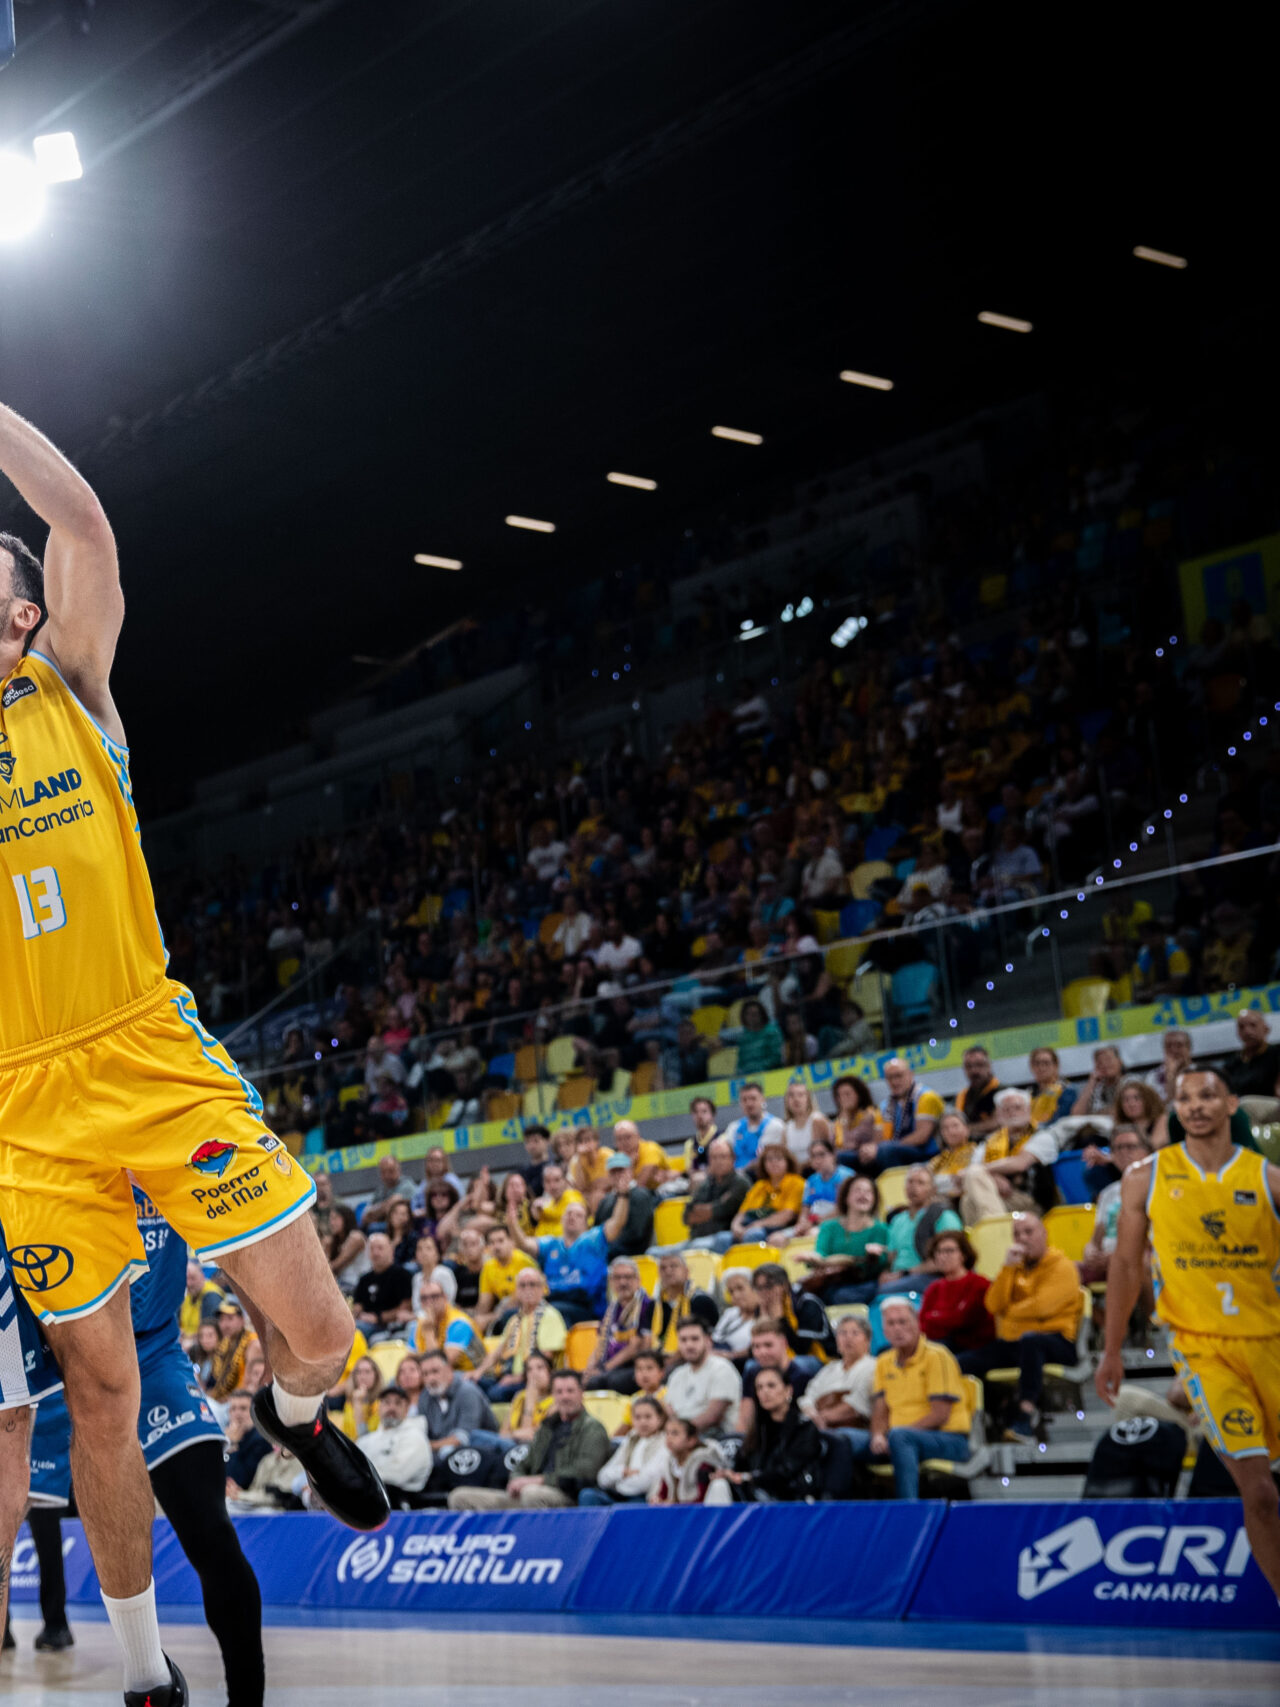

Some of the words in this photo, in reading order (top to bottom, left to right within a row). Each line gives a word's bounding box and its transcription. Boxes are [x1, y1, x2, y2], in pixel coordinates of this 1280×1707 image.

[4, 684, 35, 706] endesa
[11, 865, 68, 940] 13
[191, 1166, 260, 1203] Poema
[206, 1199, 232, 1220] del
[231, 1180, 269, 1207] Mar
[1216, 1282, 1240, 1316] 2
[139, 1410, 196, 1450] LEXUS
[402, 1533, 517, 1556] GRUPO
[387, 1554, 564, 1584] solitium
[1093, 1581, 1238, 1604] CANARIAS
